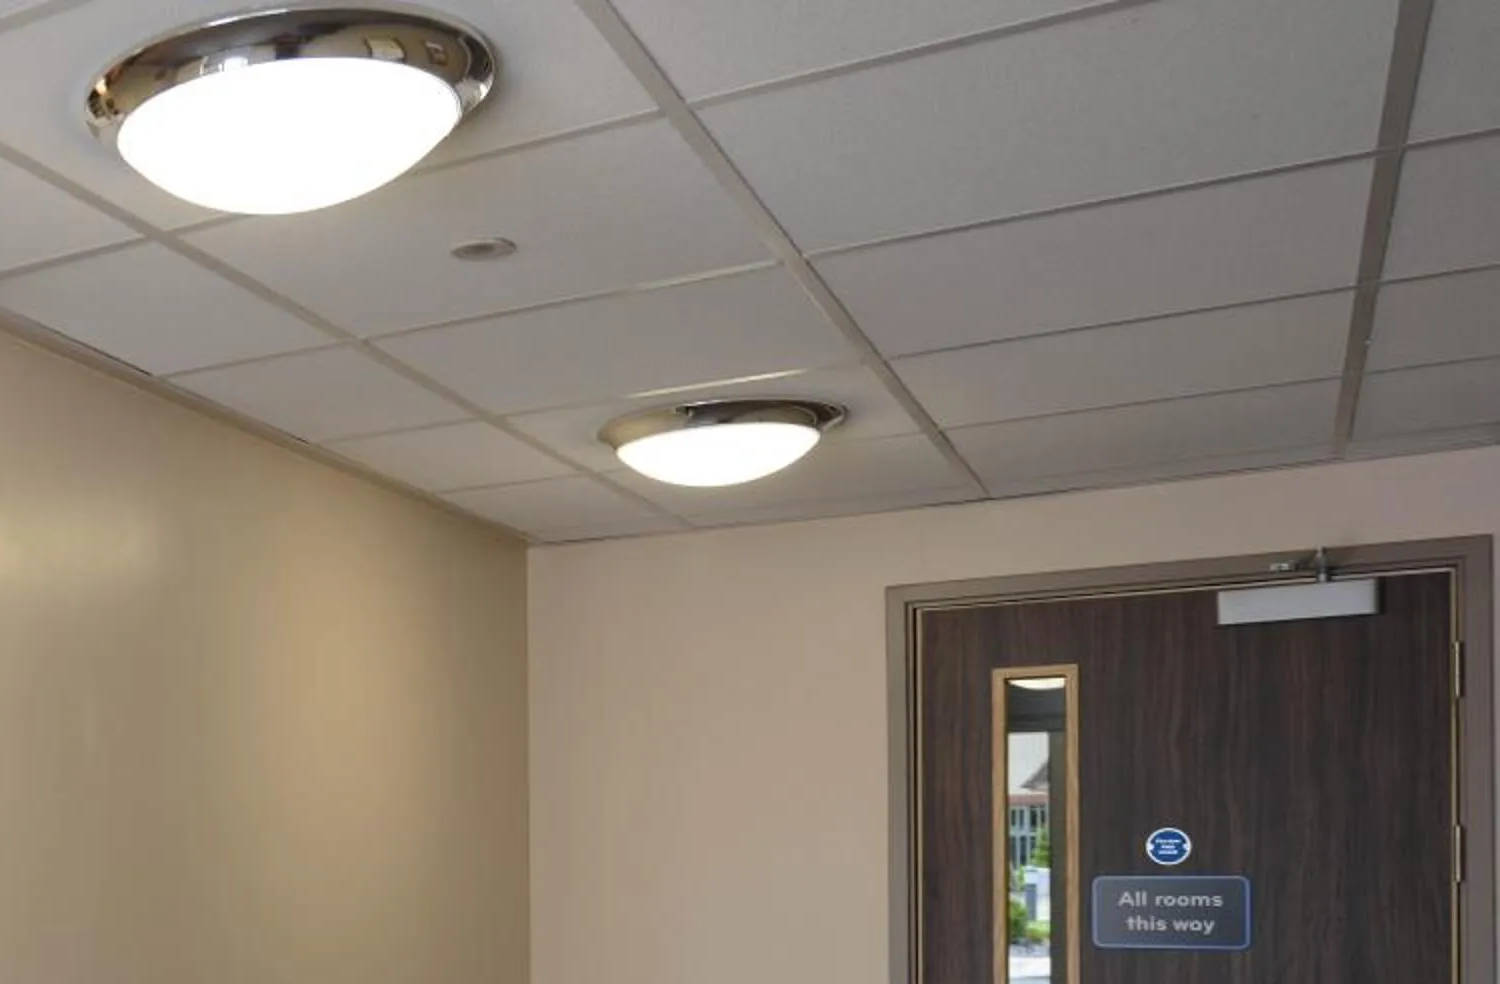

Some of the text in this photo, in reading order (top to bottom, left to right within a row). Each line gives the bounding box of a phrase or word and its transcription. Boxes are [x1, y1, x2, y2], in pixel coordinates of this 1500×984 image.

[1118, 890, 1224, 908] All rooms
[1126, 915, 1215, 935] this way
